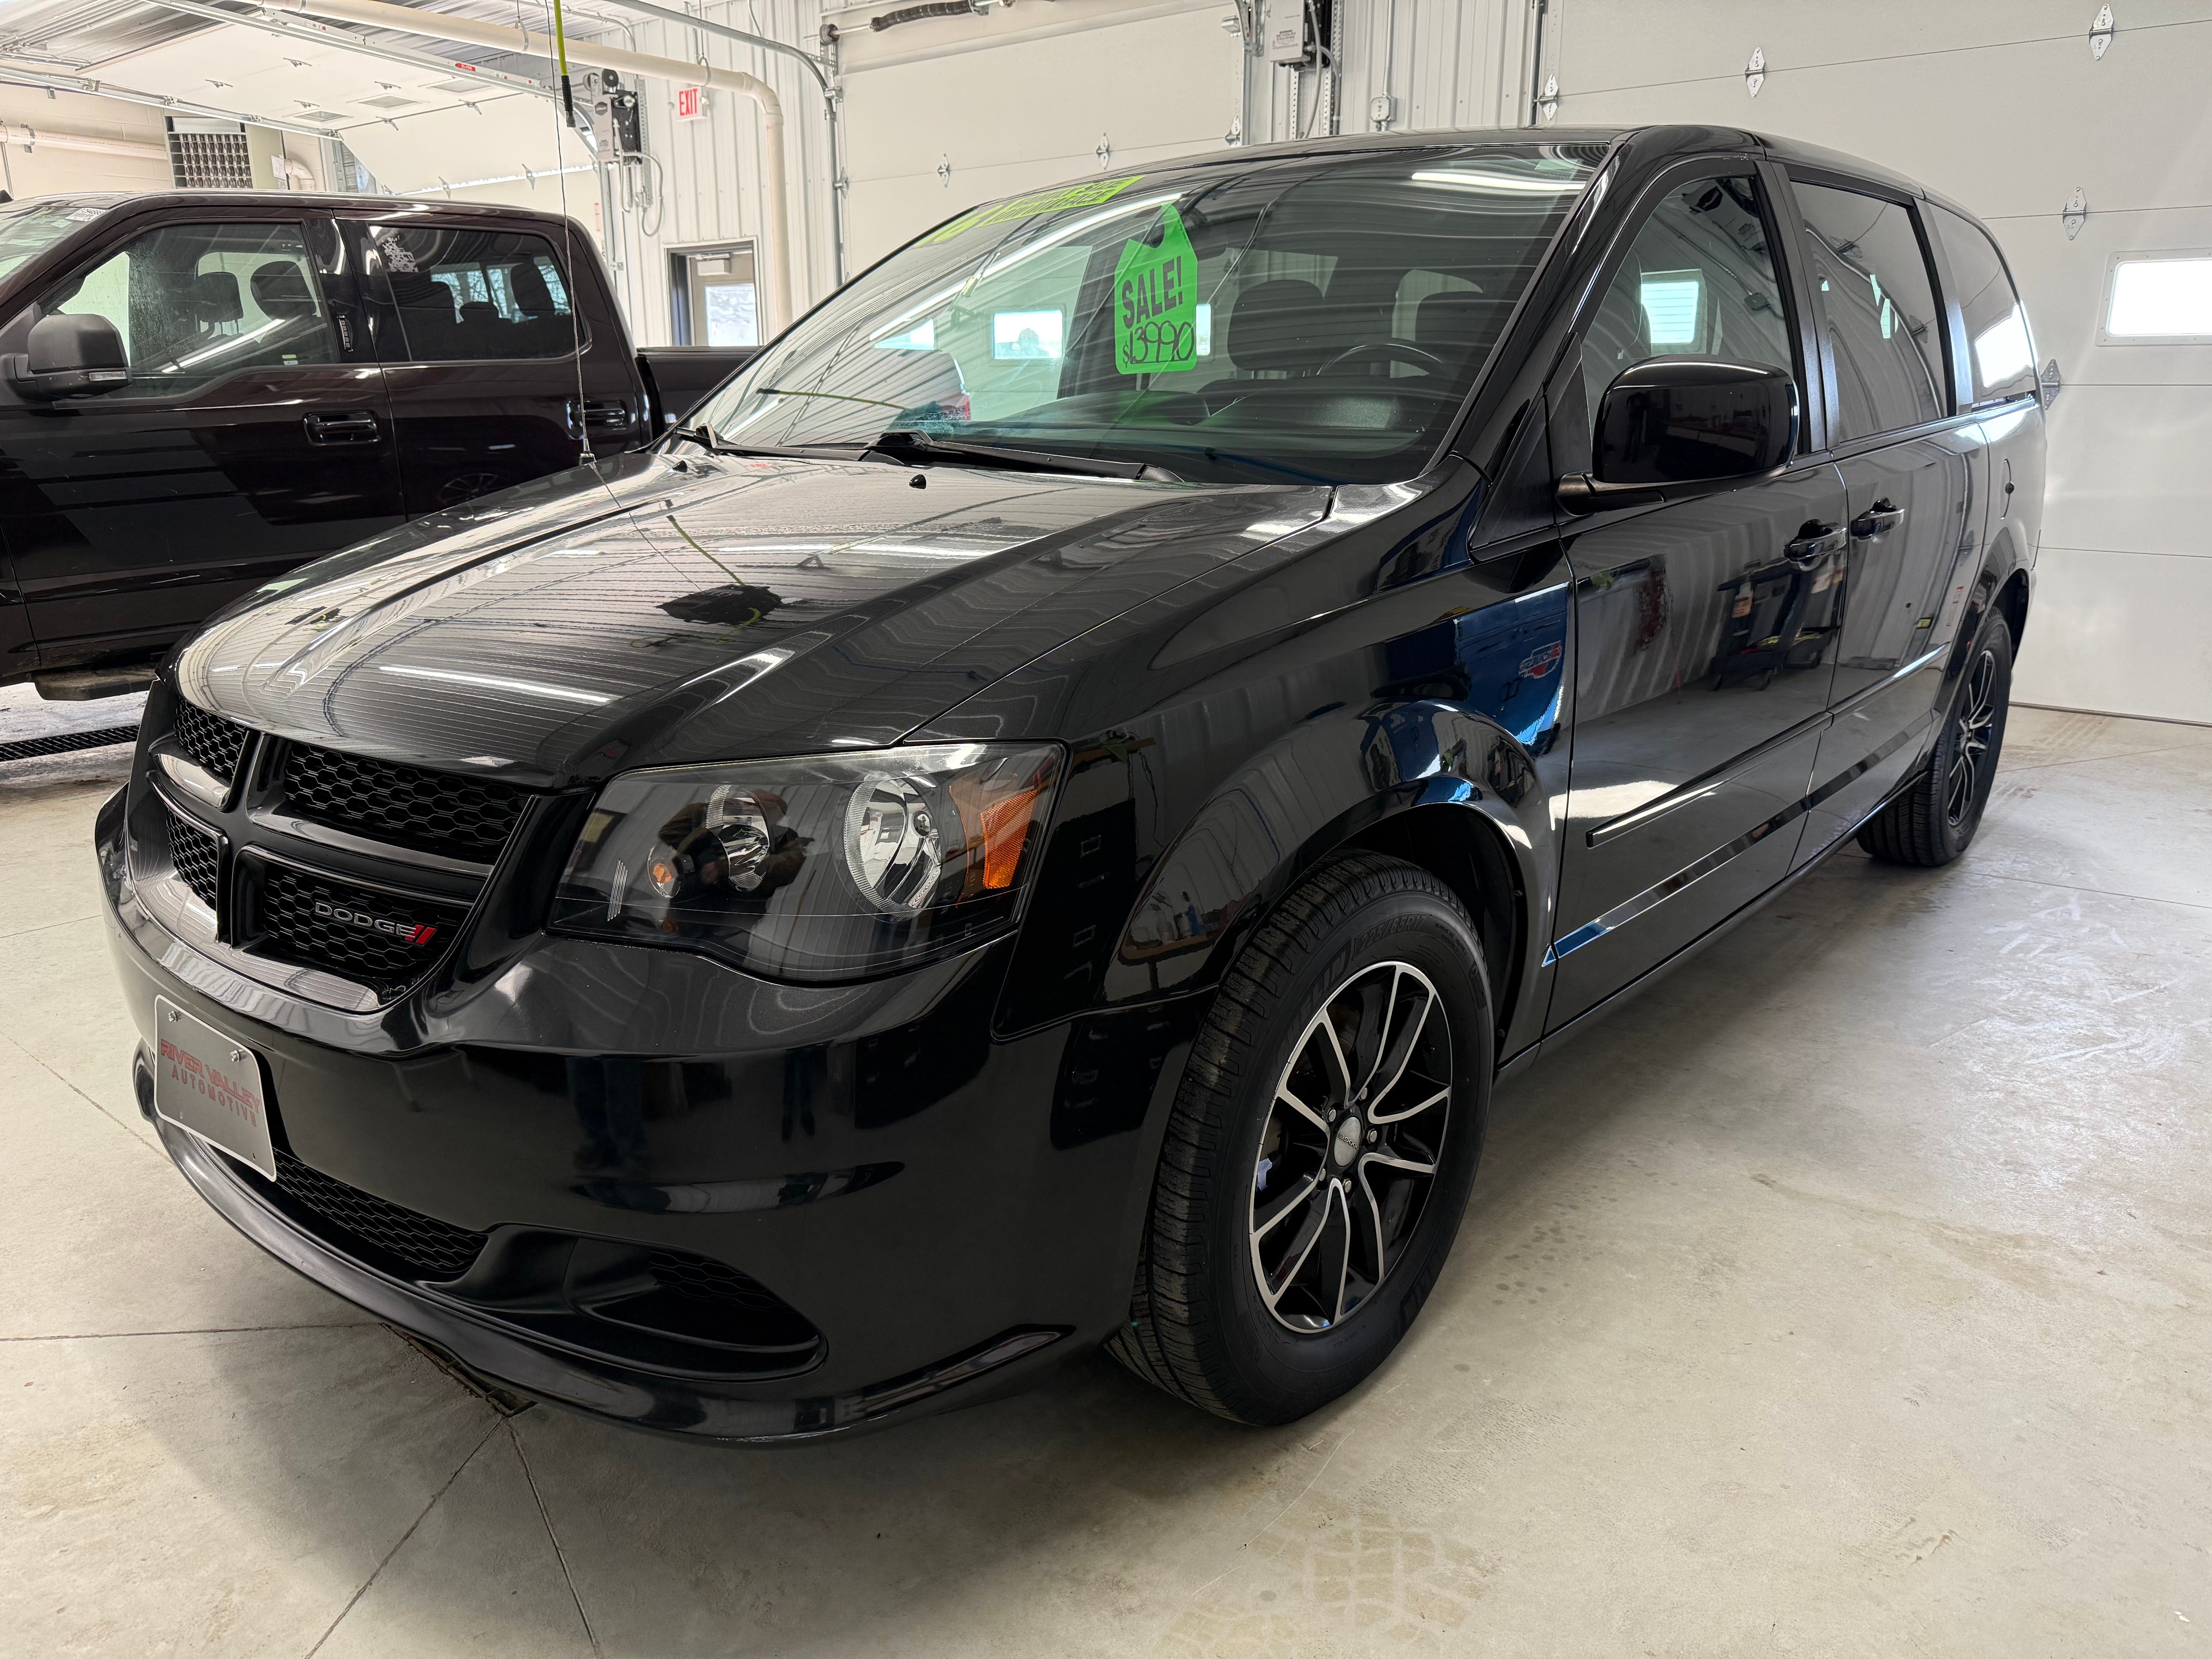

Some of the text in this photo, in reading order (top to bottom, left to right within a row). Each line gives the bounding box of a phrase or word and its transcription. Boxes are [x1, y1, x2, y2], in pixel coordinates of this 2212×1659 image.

[679, 88, 698, 116] EXIT
[1122, 256, 1183, 328] SALE!
[315, 902, 416, 939] DODGE
[1359, 915, 1427, 952] 225/65R17
[161, 1039, 261, 1113] RIVER VALLEY
[172, 1065, 257, 1127] AUTOMOTIVE
[1338, 1133, 1359, 1151] DODGE
